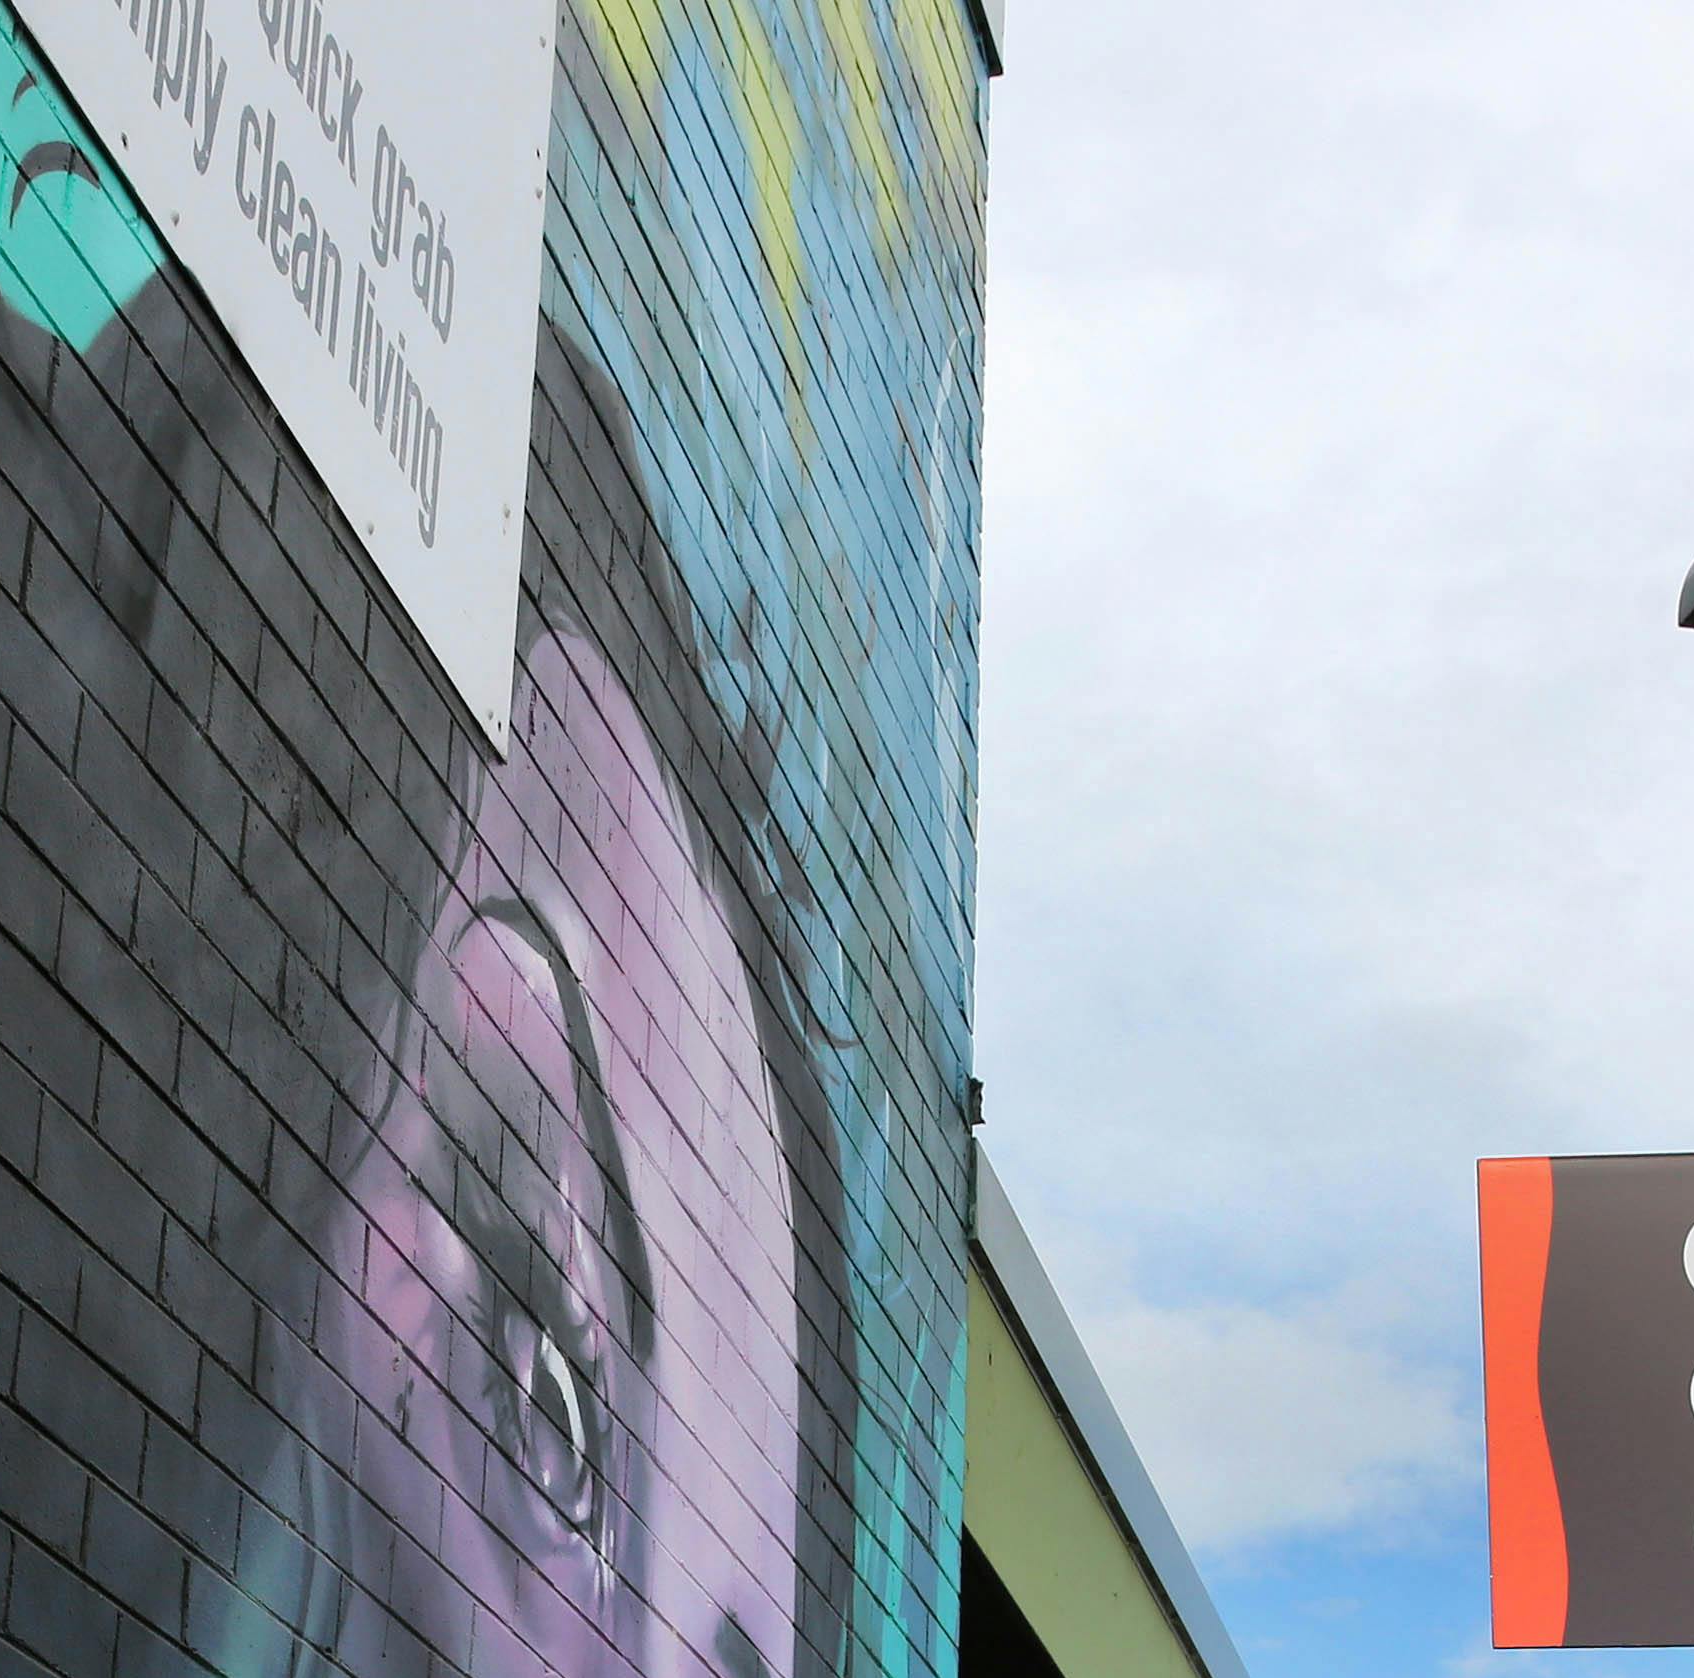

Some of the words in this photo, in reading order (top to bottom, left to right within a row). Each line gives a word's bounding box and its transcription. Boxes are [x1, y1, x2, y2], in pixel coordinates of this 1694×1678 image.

[114, 0, 228, 176] ply
[236, 104, 342, 358] clean
[350, 262, 443, 549] living
[371, 124, 455, 345] grab
